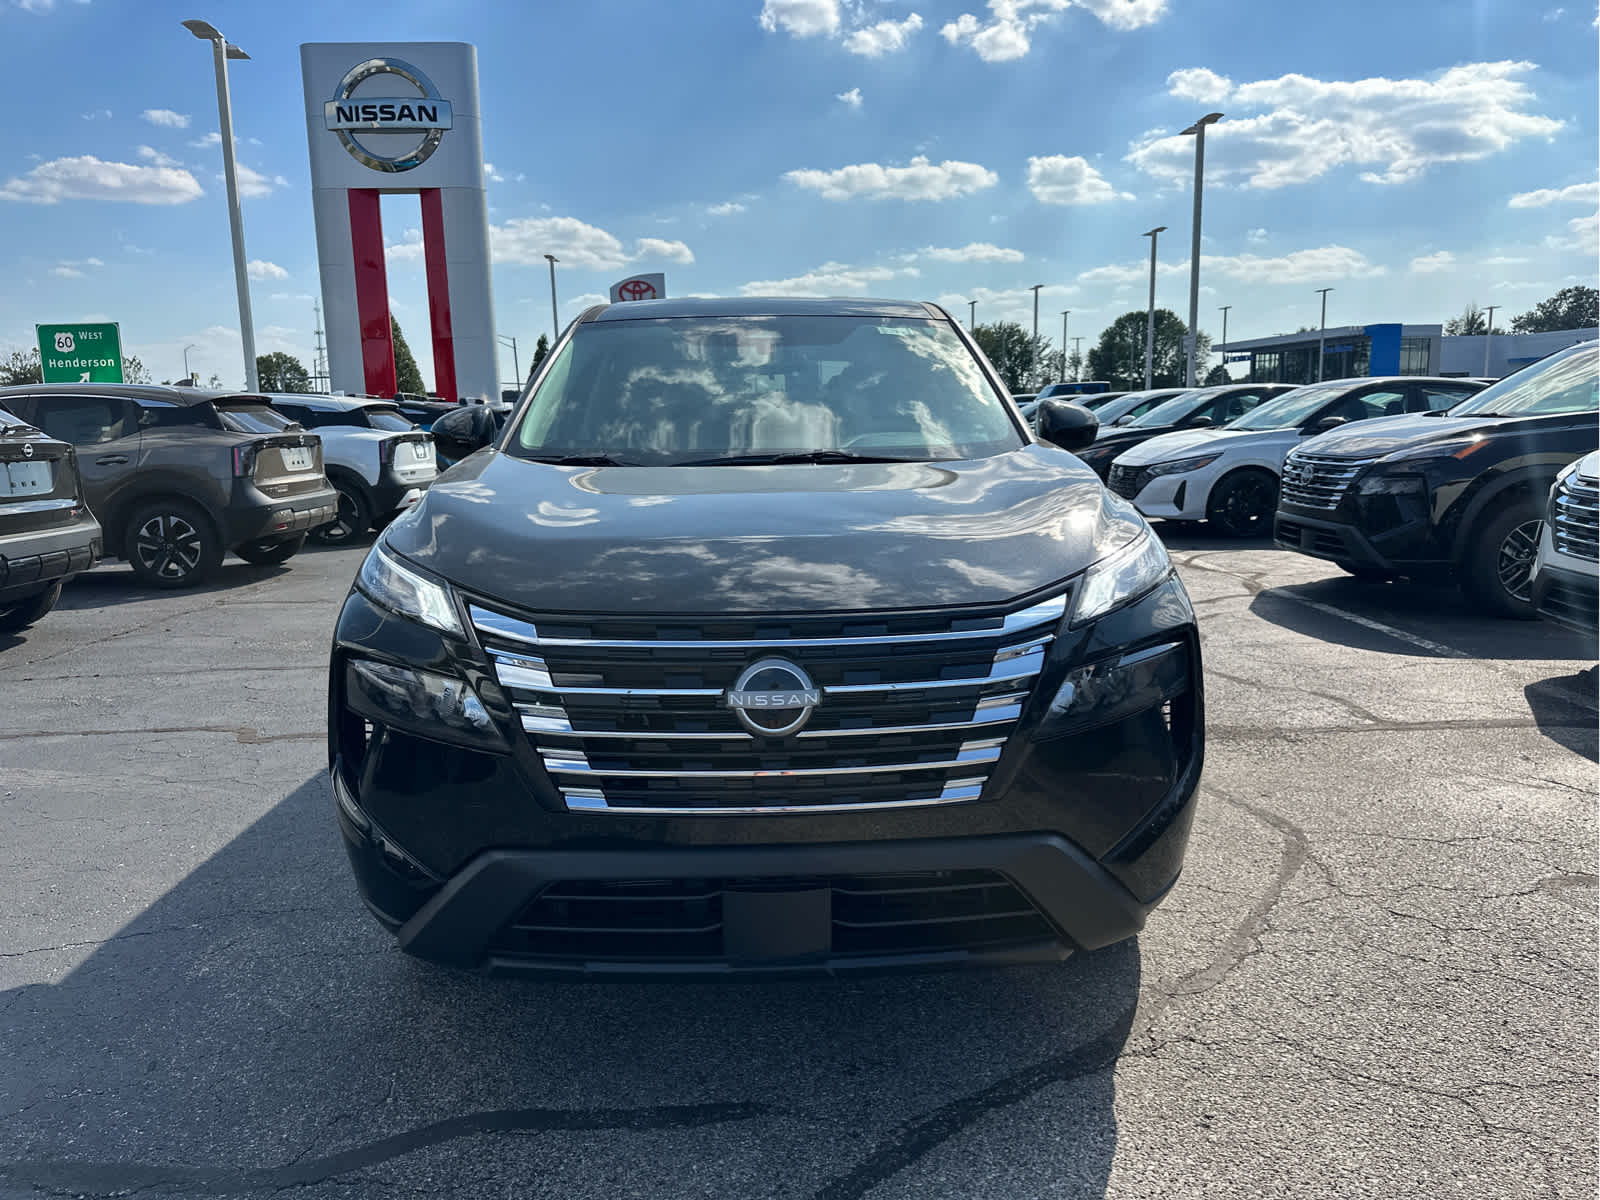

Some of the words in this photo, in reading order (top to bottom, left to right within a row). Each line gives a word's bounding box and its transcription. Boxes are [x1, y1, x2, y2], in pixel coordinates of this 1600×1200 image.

[336, 104, 438, 123] NISSAN
[57, 336, 73, 348] 60
[78, 331, 103, 340] WEST
[48, 357, 115, 368] Henderson
[729, 693, 818, 705] NISSAN
